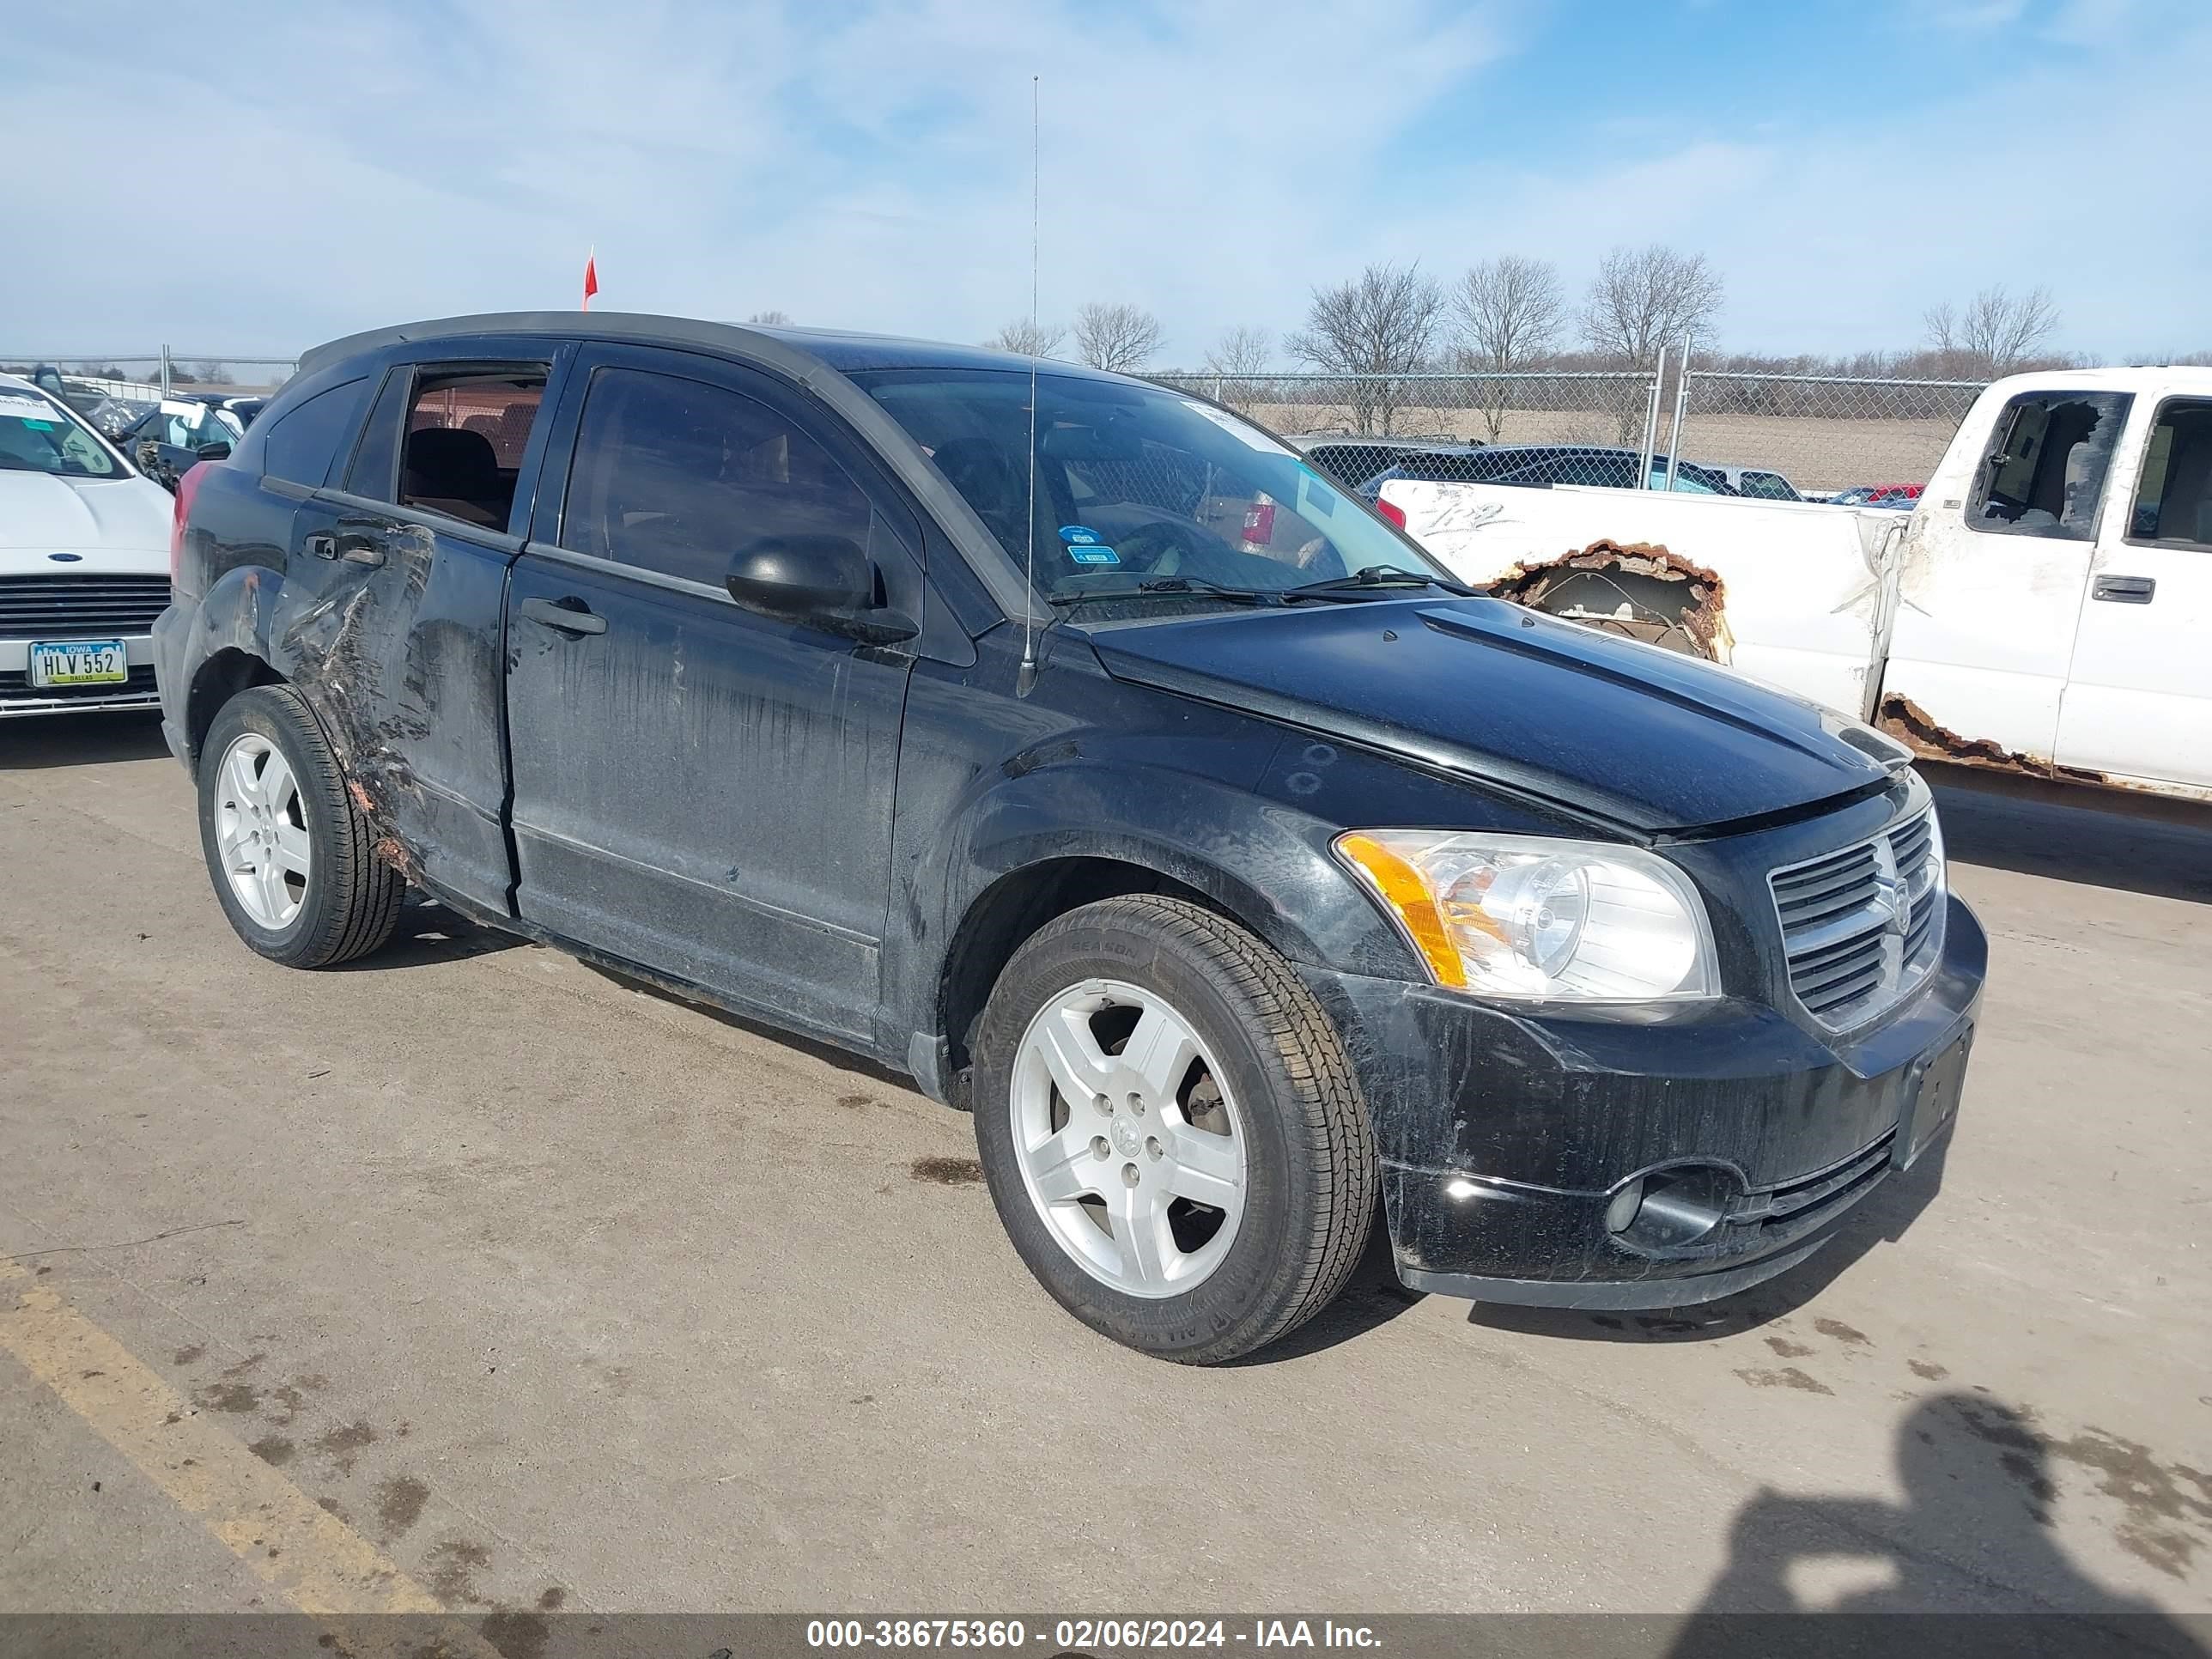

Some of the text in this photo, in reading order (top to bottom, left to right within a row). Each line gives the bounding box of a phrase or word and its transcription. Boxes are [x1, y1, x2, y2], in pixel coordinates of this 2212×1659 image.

[66, 646, 93, 654] IOWA
[44, 653, 114, 676] HLV 552
